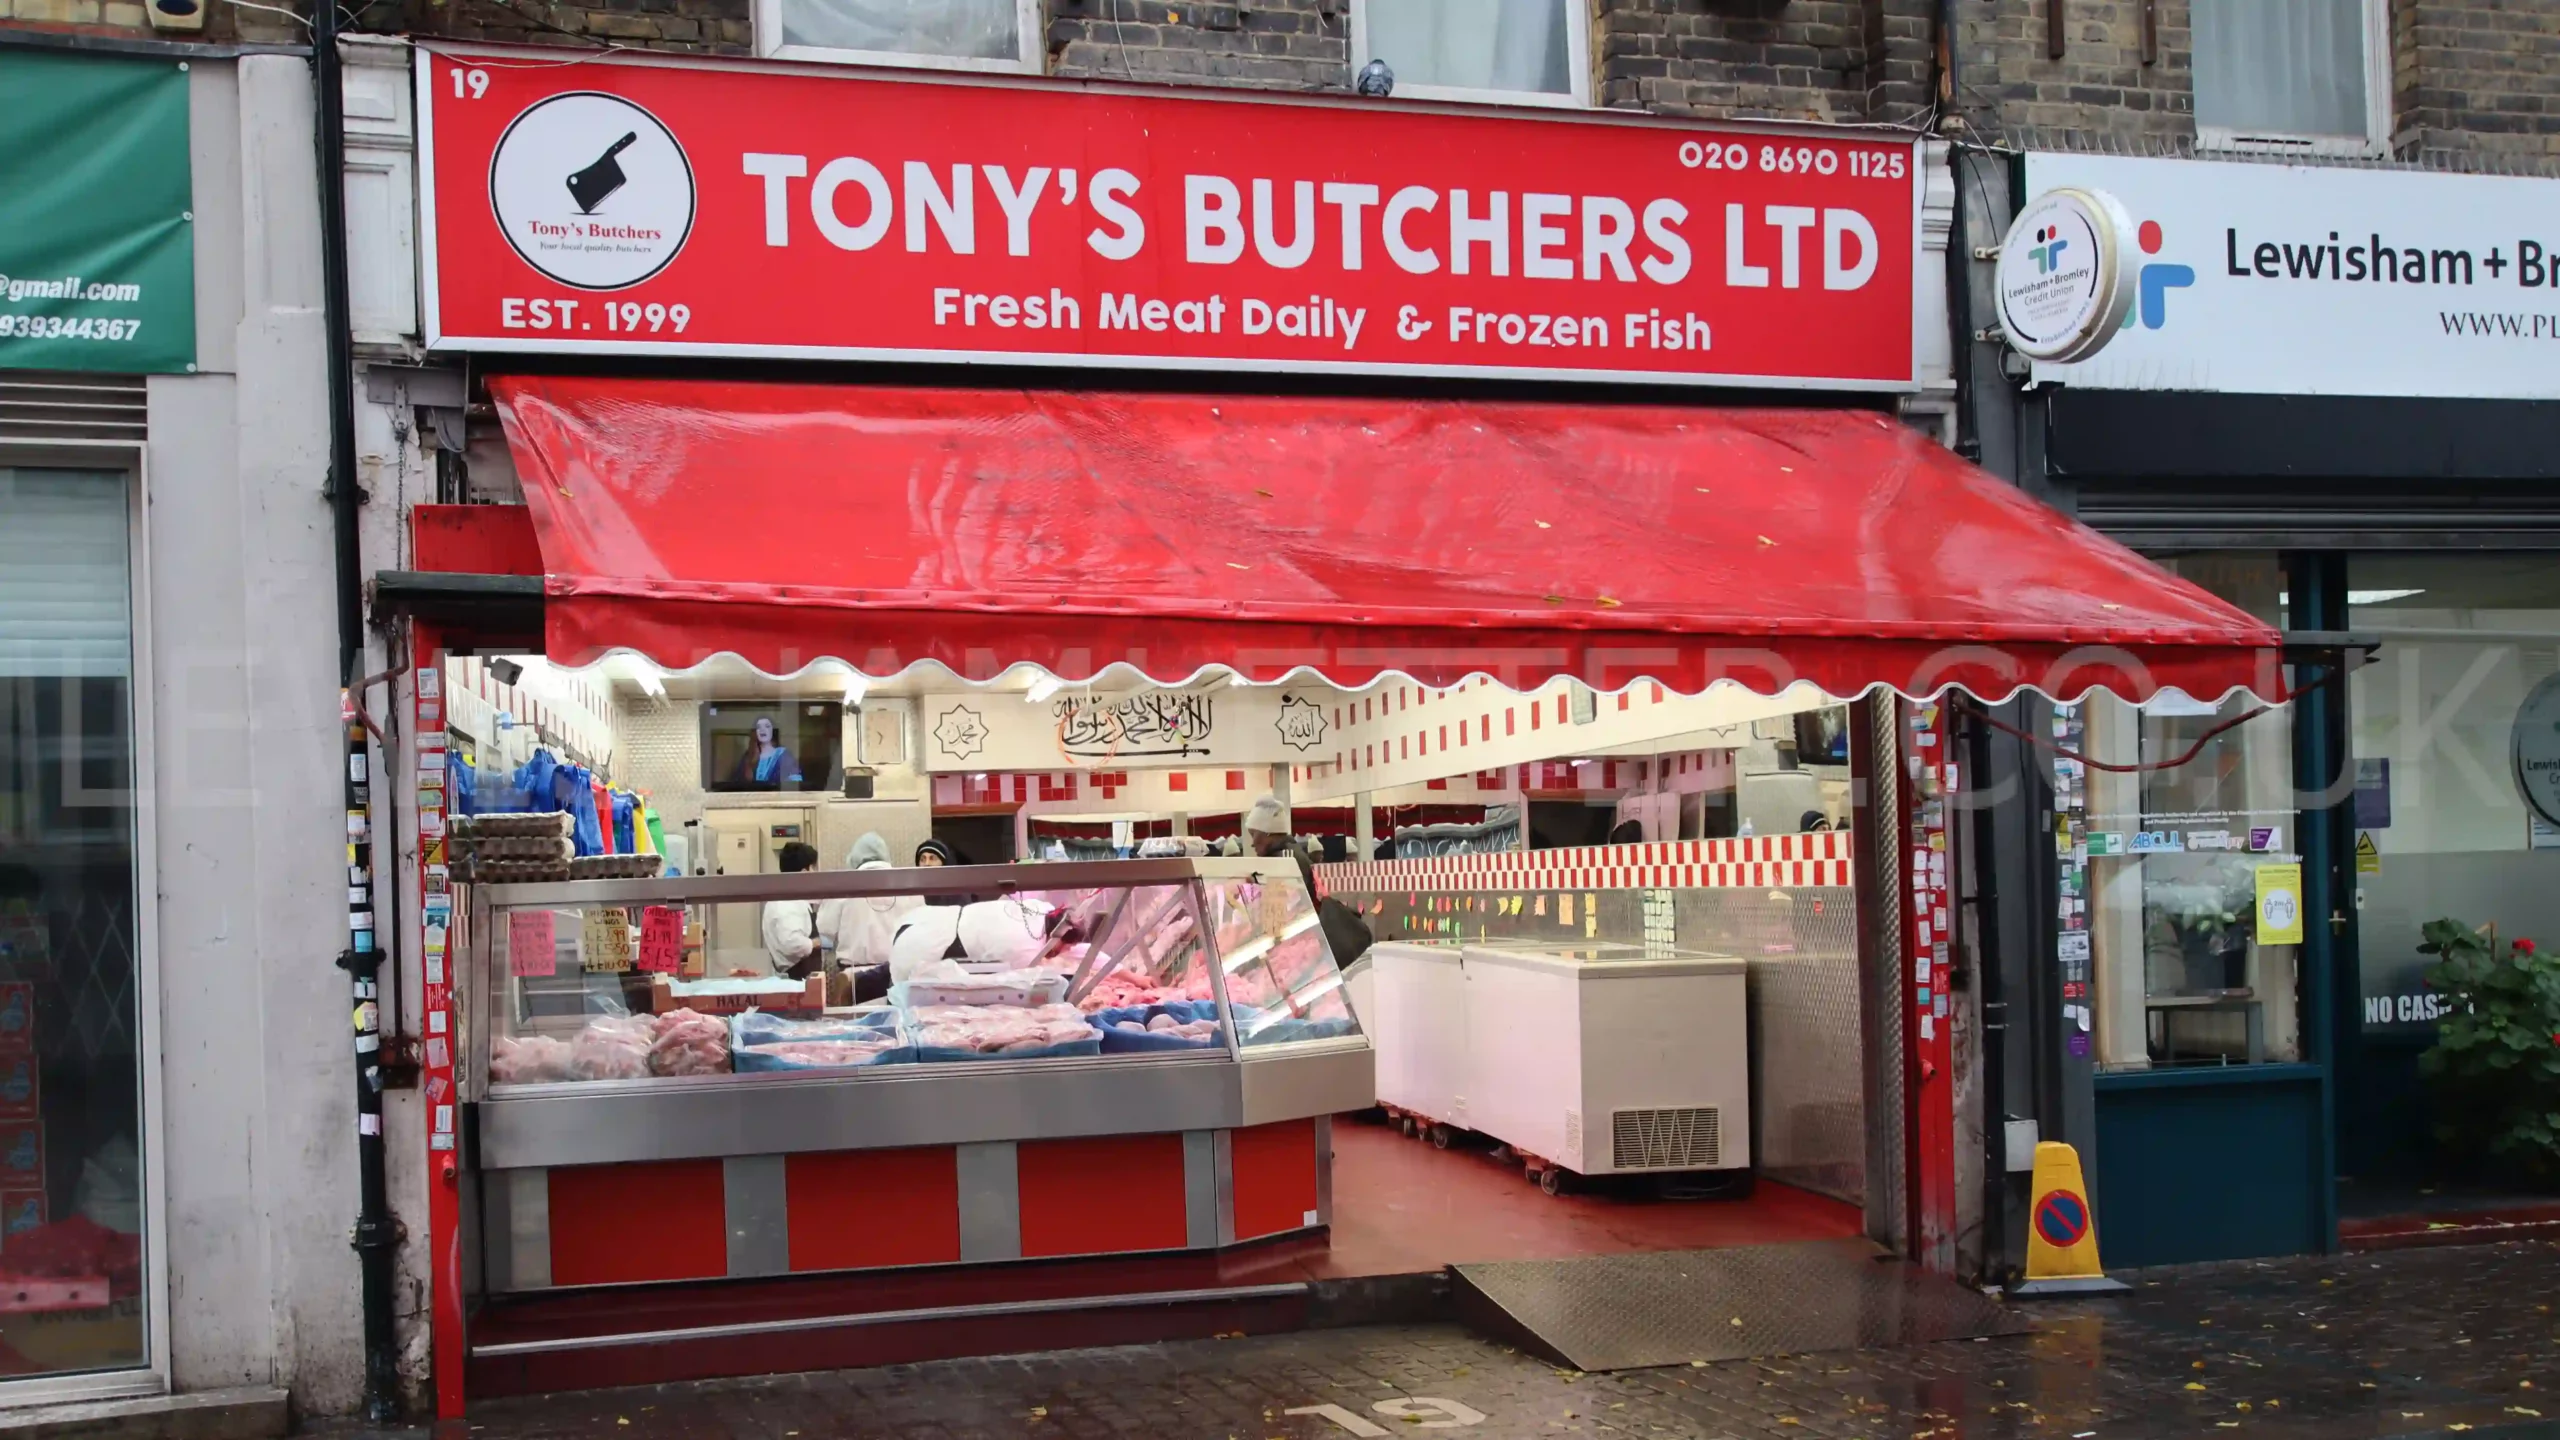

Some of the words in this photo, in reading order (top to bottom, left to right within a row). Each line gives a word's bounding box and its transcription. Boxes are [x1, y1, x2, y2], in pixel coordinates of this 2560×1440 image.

[450, 67, 490, 100] 19
[1679, 141, 1748, 172] 020
[1759, 145, 1838, 177] 8690
[1848, 150, 1905, 180] 1125
[588, 222, 662, 241] Butchers
[742, 152, 1145, 261] TONY'S
[1184, 173, 1692, 286] BUTCHERS
[1725, 202, 1879, 292] LTD
[540, 241, 558, 251] Your
[584, 243, 614, 253] quality
[2008, 276, 2049, 299] Lewisham
[2054, 267, 2090, 286] Bromley
[2024, 289, 2049, 307] Credit
[2050, 283, 2075, 299] Union
[501, 297, 592, 331] EST.
[604, 301, 691, 333] 1999
[933, 286, 1081, 331] Fresh
[1098, 292, 1226, 334] Meat
[1241, 298, 1367, 351] Daily
[1396, 305, 1433, 342] &
[1449, 306, 1609, 349] Frozen
[1625, 309, 1712, 351] Fish
[2128, 831, 2184, 849] ABCUL
[716, 995, 761, 1008] HALAL
[2364, 995, 2393, 1024] NO
